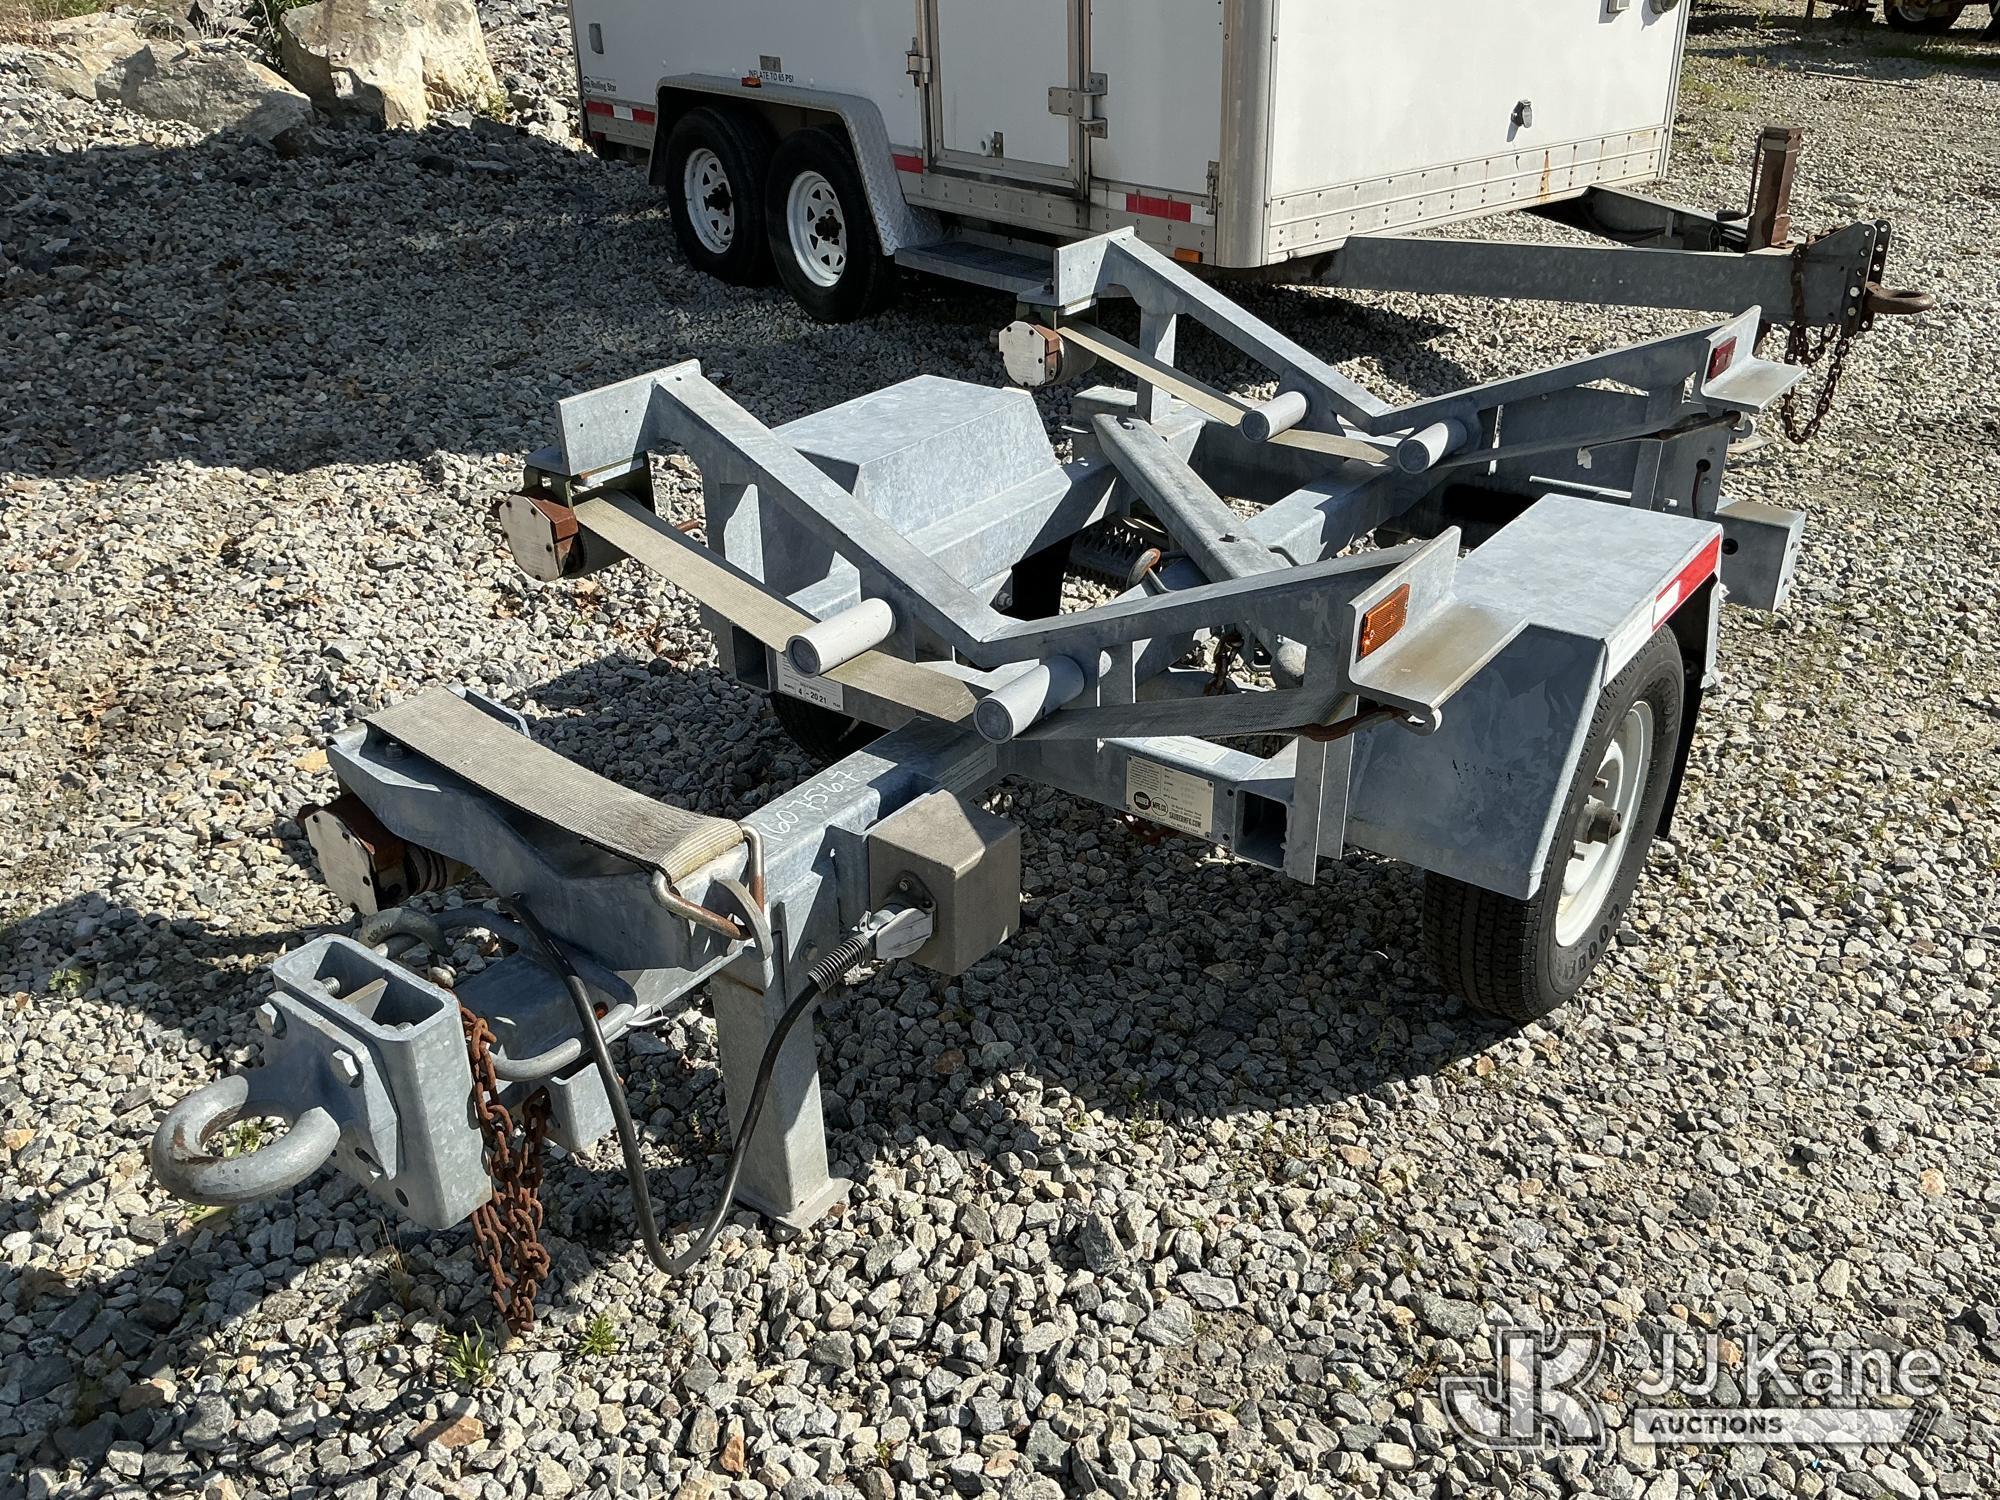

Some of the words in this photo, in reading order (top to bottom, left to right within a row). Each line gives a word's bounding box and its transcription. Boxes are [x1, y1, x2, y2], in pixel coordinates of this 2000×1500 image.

[748, 69, 769, 80] INFLATE
[770, 72, 778, 81] TO
[759, 770, 861, 842] 1607567
